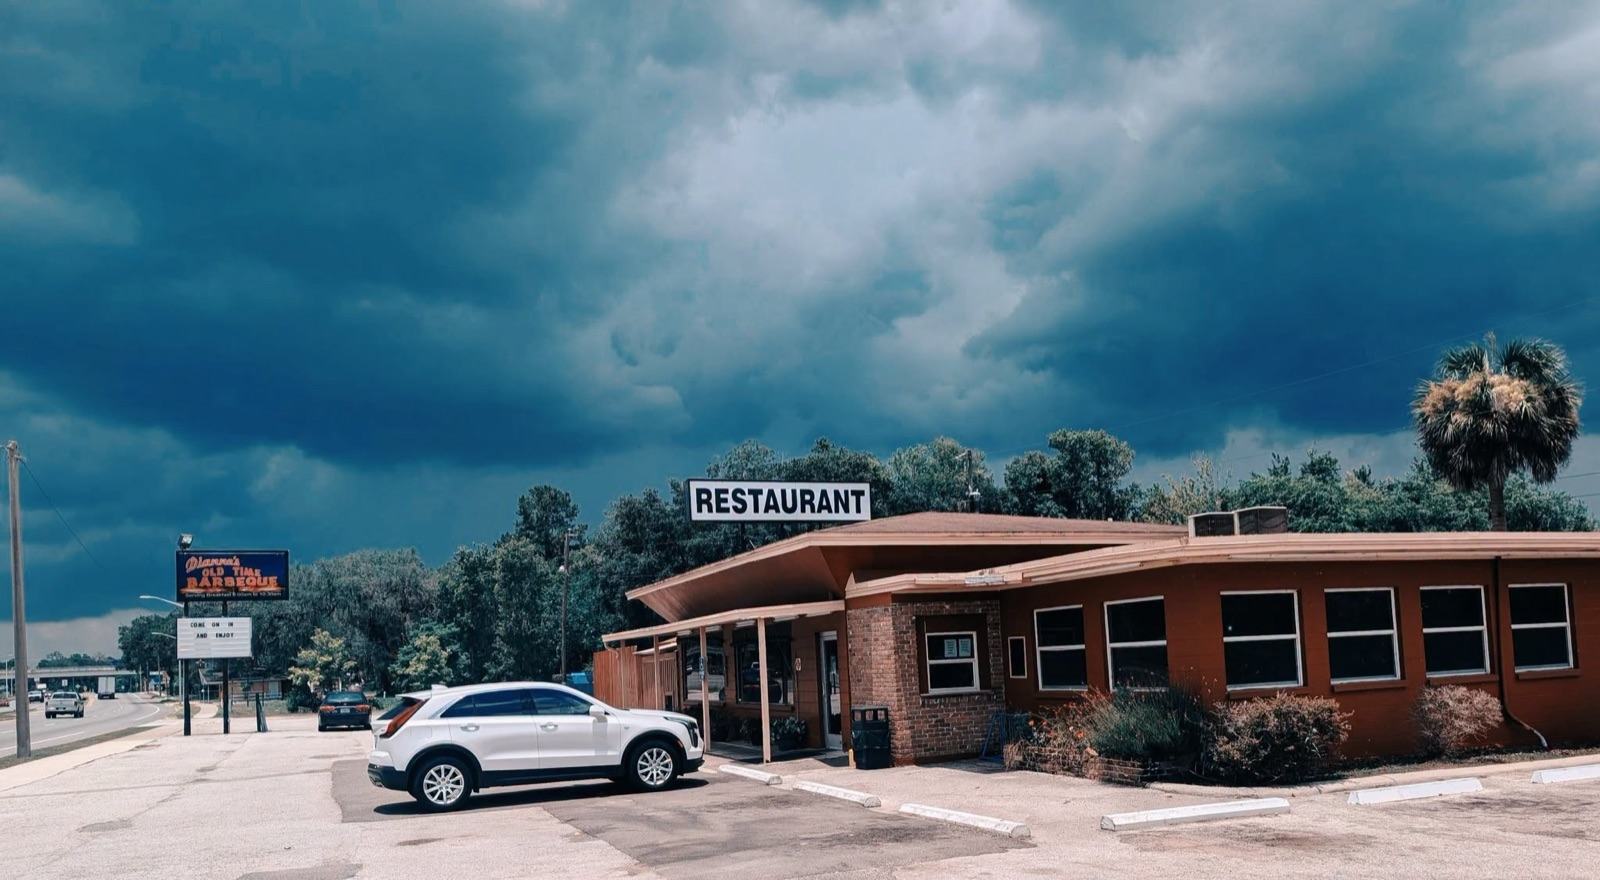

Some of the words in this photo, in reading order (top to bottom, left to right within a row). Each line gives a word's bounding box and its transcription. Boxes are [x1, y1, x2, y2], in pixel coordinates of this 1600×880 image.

[695, 488, 866, 514] RESTAURANT
[202, 567, 224, 577] OLD
[232, 567, 261, 577] TIME
[186, 576, 278, 590] BARBEQUE
